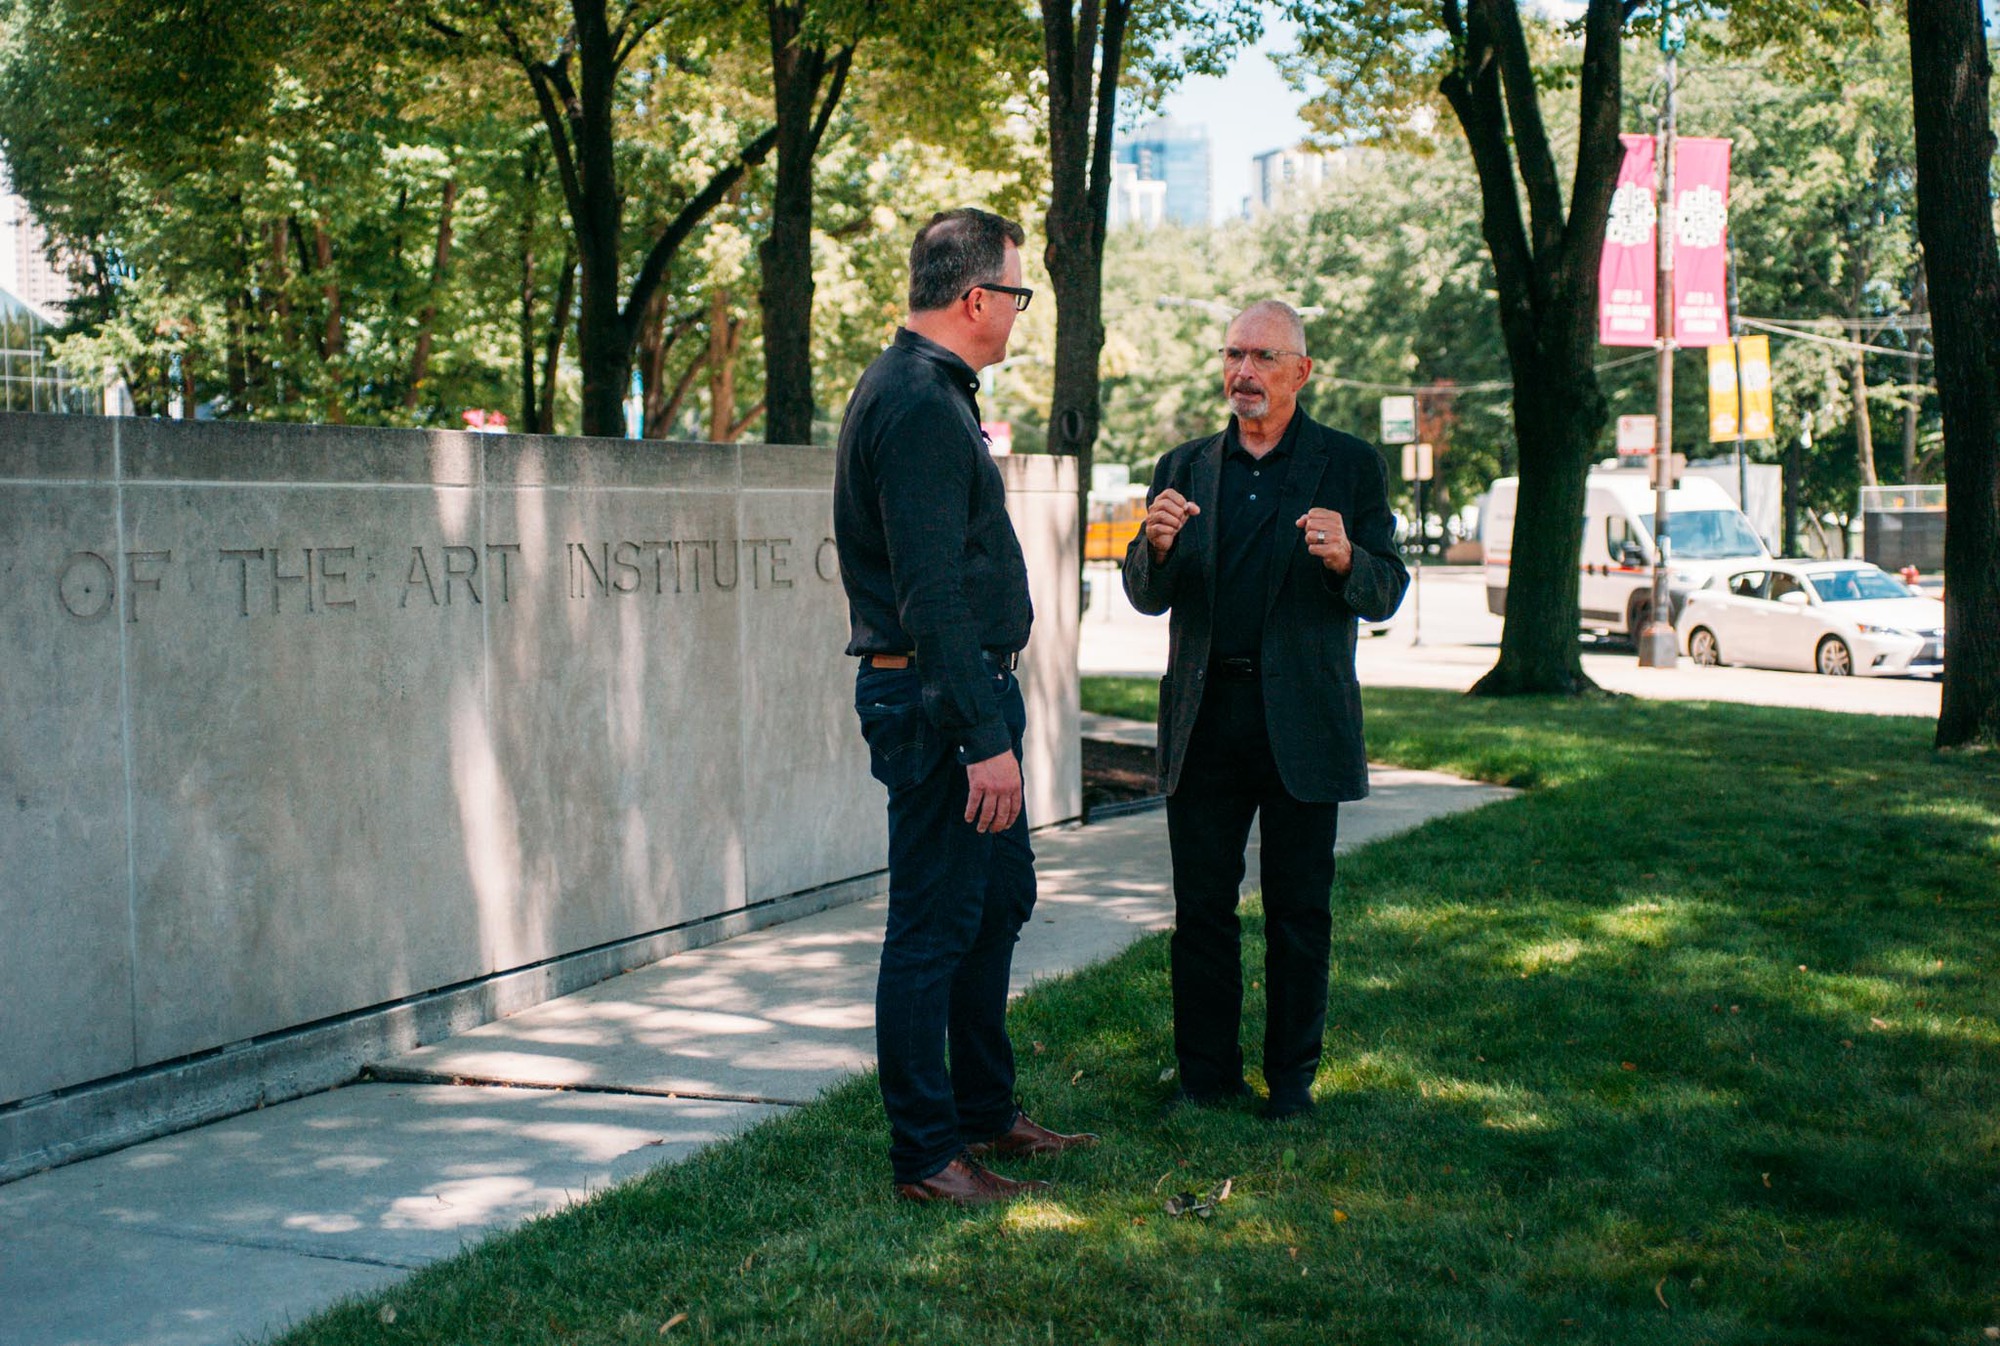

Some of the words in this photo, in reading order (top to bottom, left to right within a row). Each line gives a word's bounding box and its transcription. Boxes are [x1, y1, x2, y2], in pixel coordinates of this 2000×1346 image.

[57, 550, 172, 625] OF
[218, 546, 357, 617] THE
[398, 543, 521, 608] ART
[566, 537, 792, 599] INSTITUTE
[815, 537, 838, 583] O
